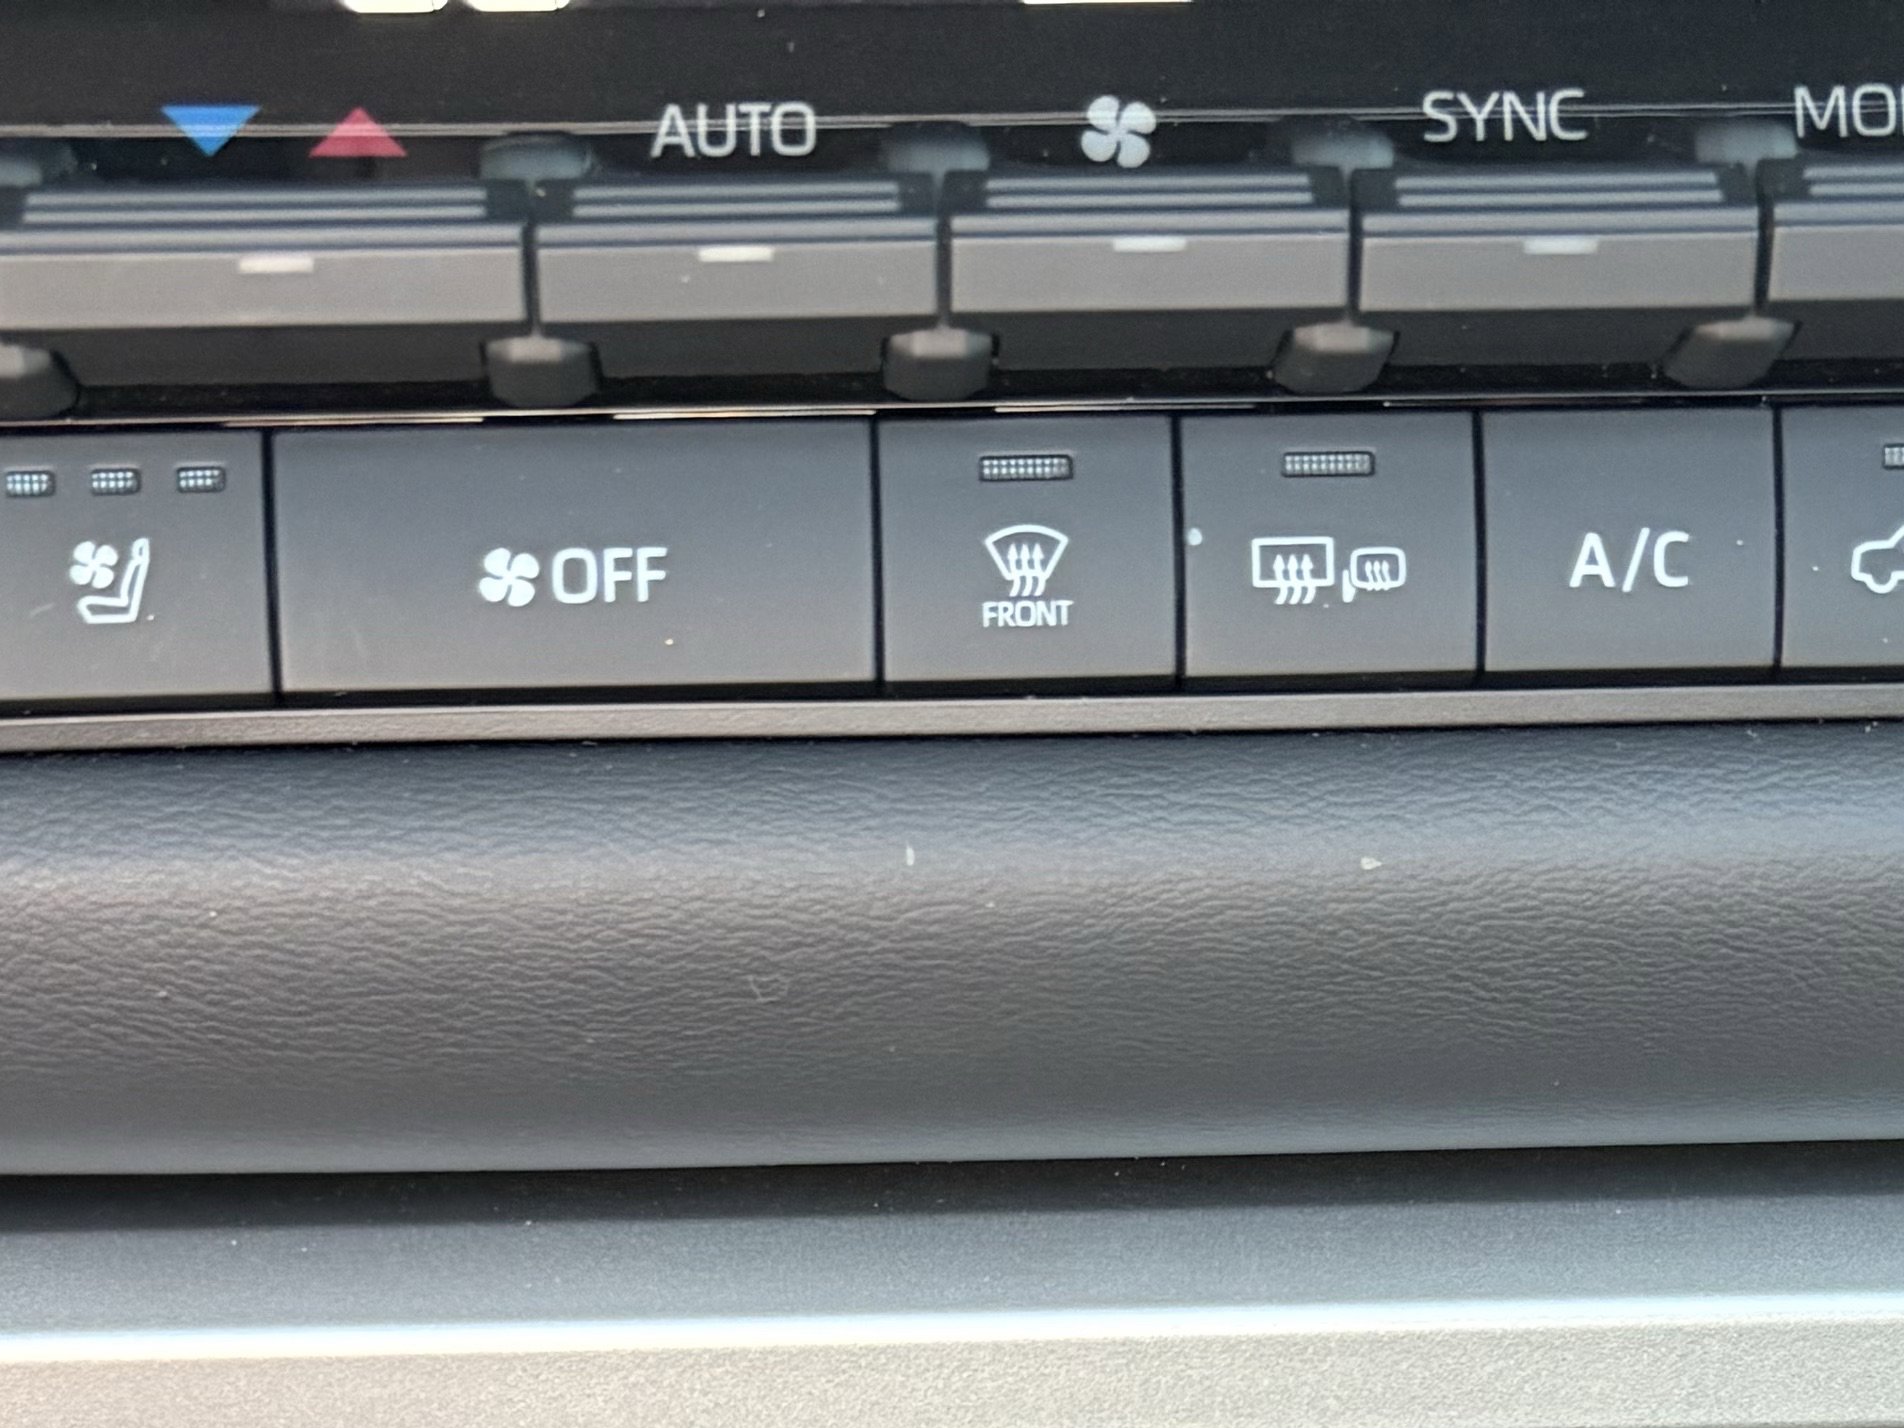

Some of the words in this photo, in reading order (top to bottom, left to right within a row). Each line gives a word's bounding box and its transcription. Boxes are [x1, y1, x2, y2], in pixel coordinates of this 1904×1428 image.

[650, 101, 818, 158] AUTO
[1422, 88, 1586, 143] SYNC
[551, 546, 668, 604] OFF
[1569, 527, 1691, 593] A/C
[981, 599, 1074, 628] FRONT
